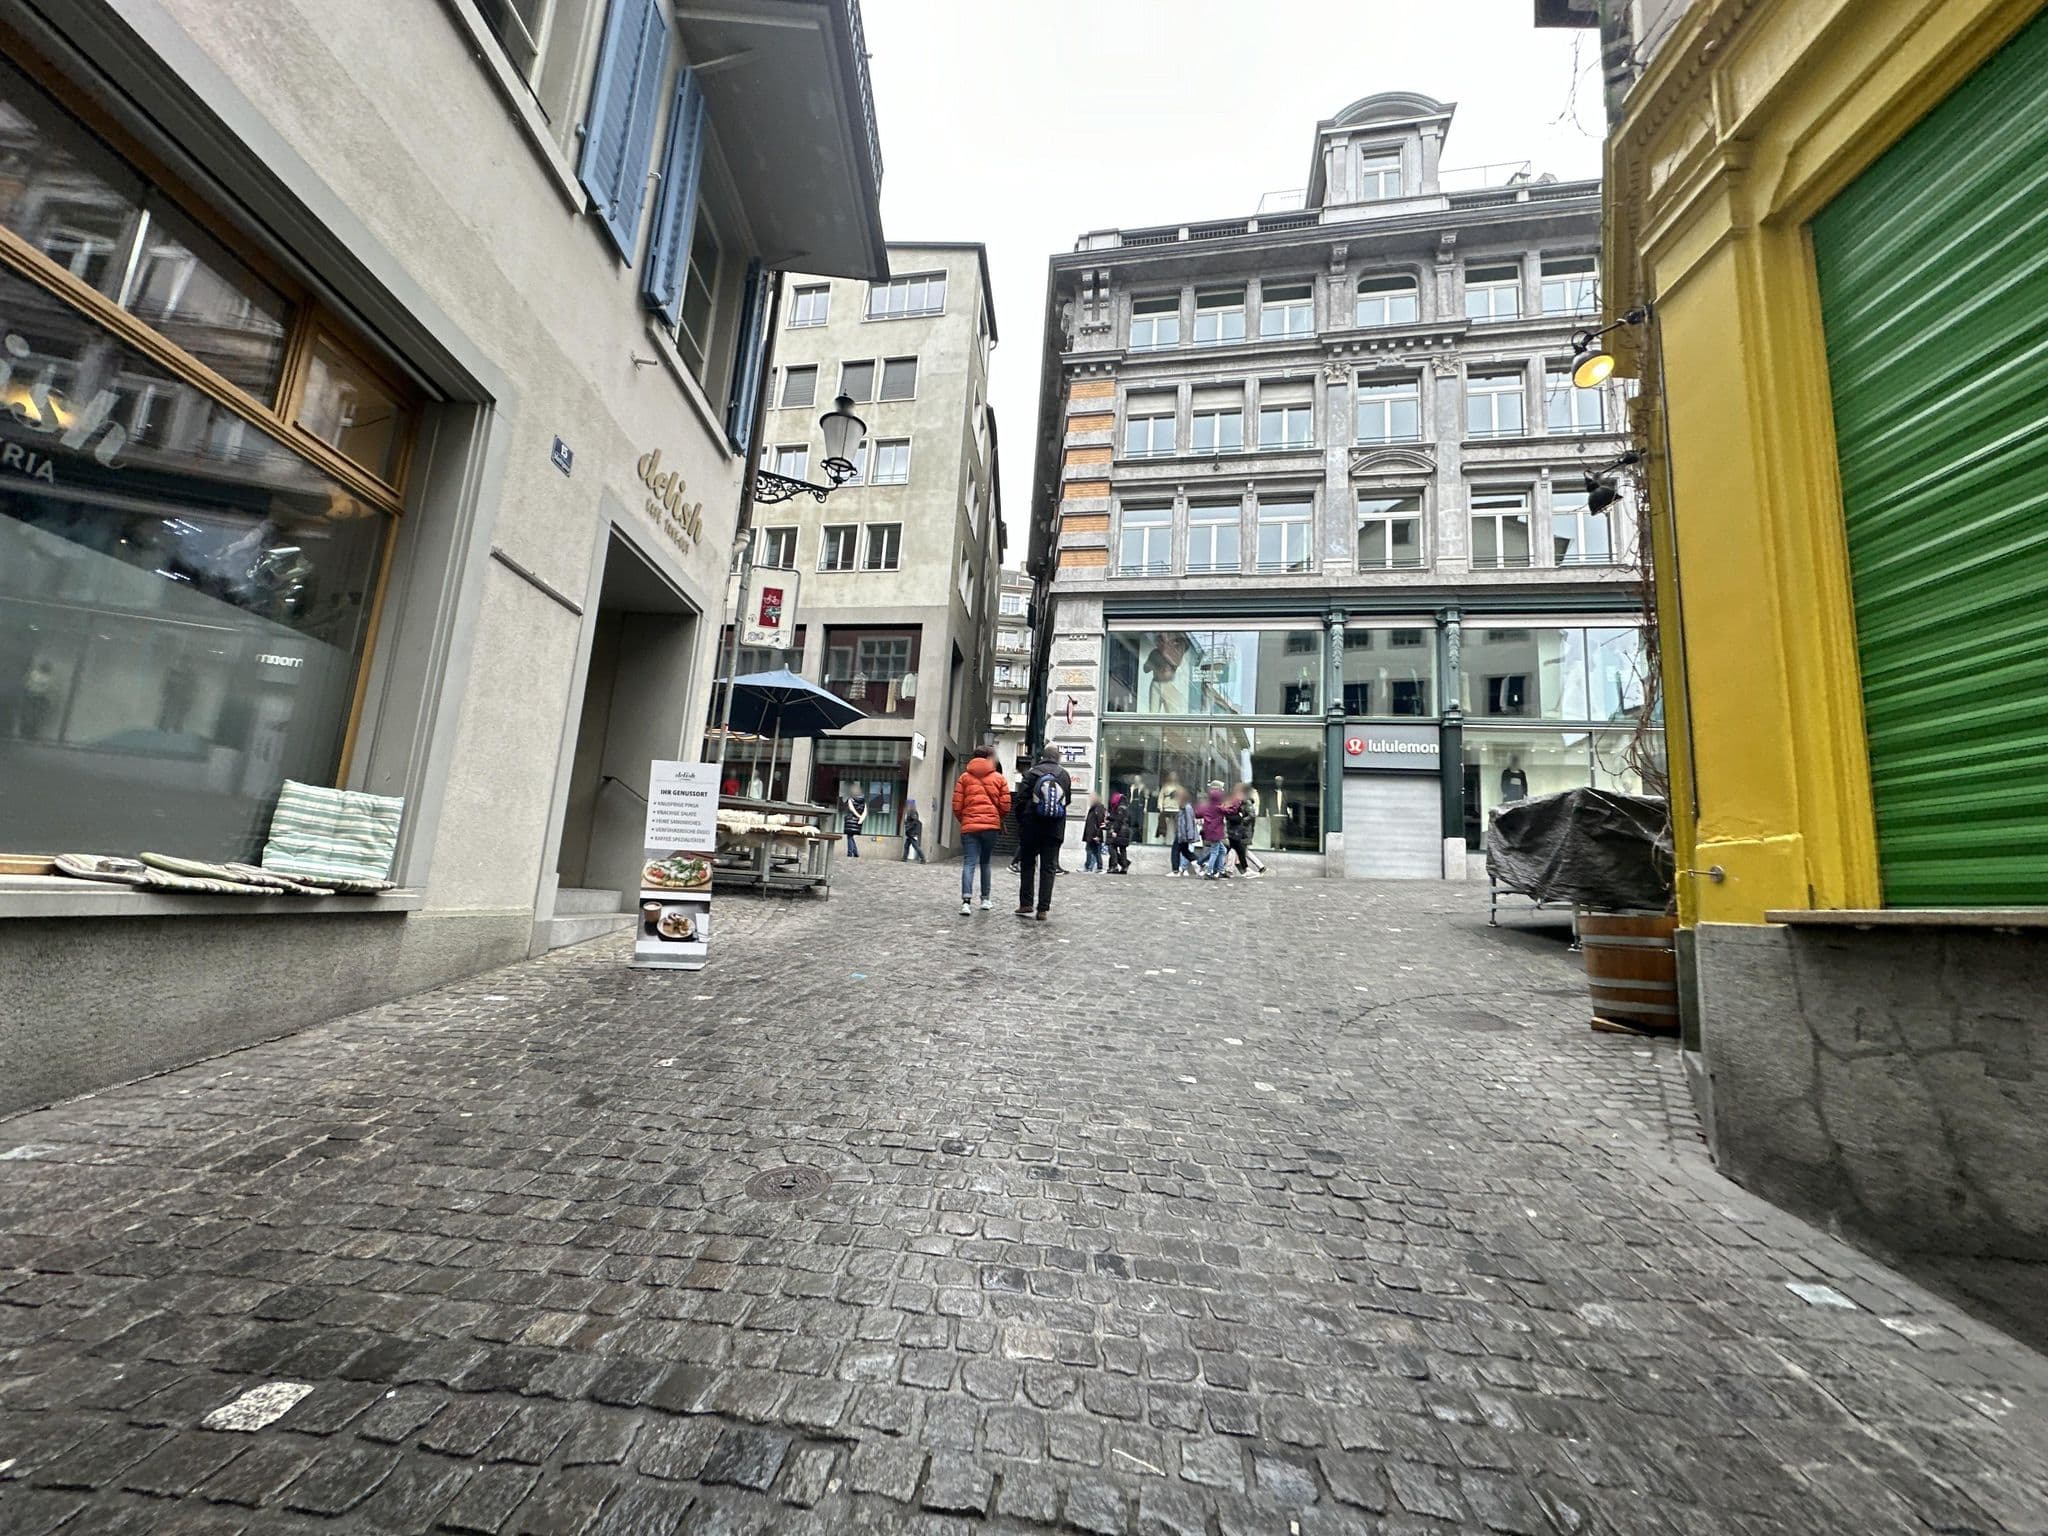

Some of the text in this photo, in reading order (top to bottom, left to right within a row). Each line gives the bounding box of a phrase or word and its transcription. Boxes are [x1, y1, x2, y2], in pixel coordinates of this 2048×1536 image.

[0, 436, 55, 484] RIA
[637, 448, 703, 545] delish
[1368, 738, 1440, 754] lululemon
[672, 790, 708, 798] GENUSSORT
